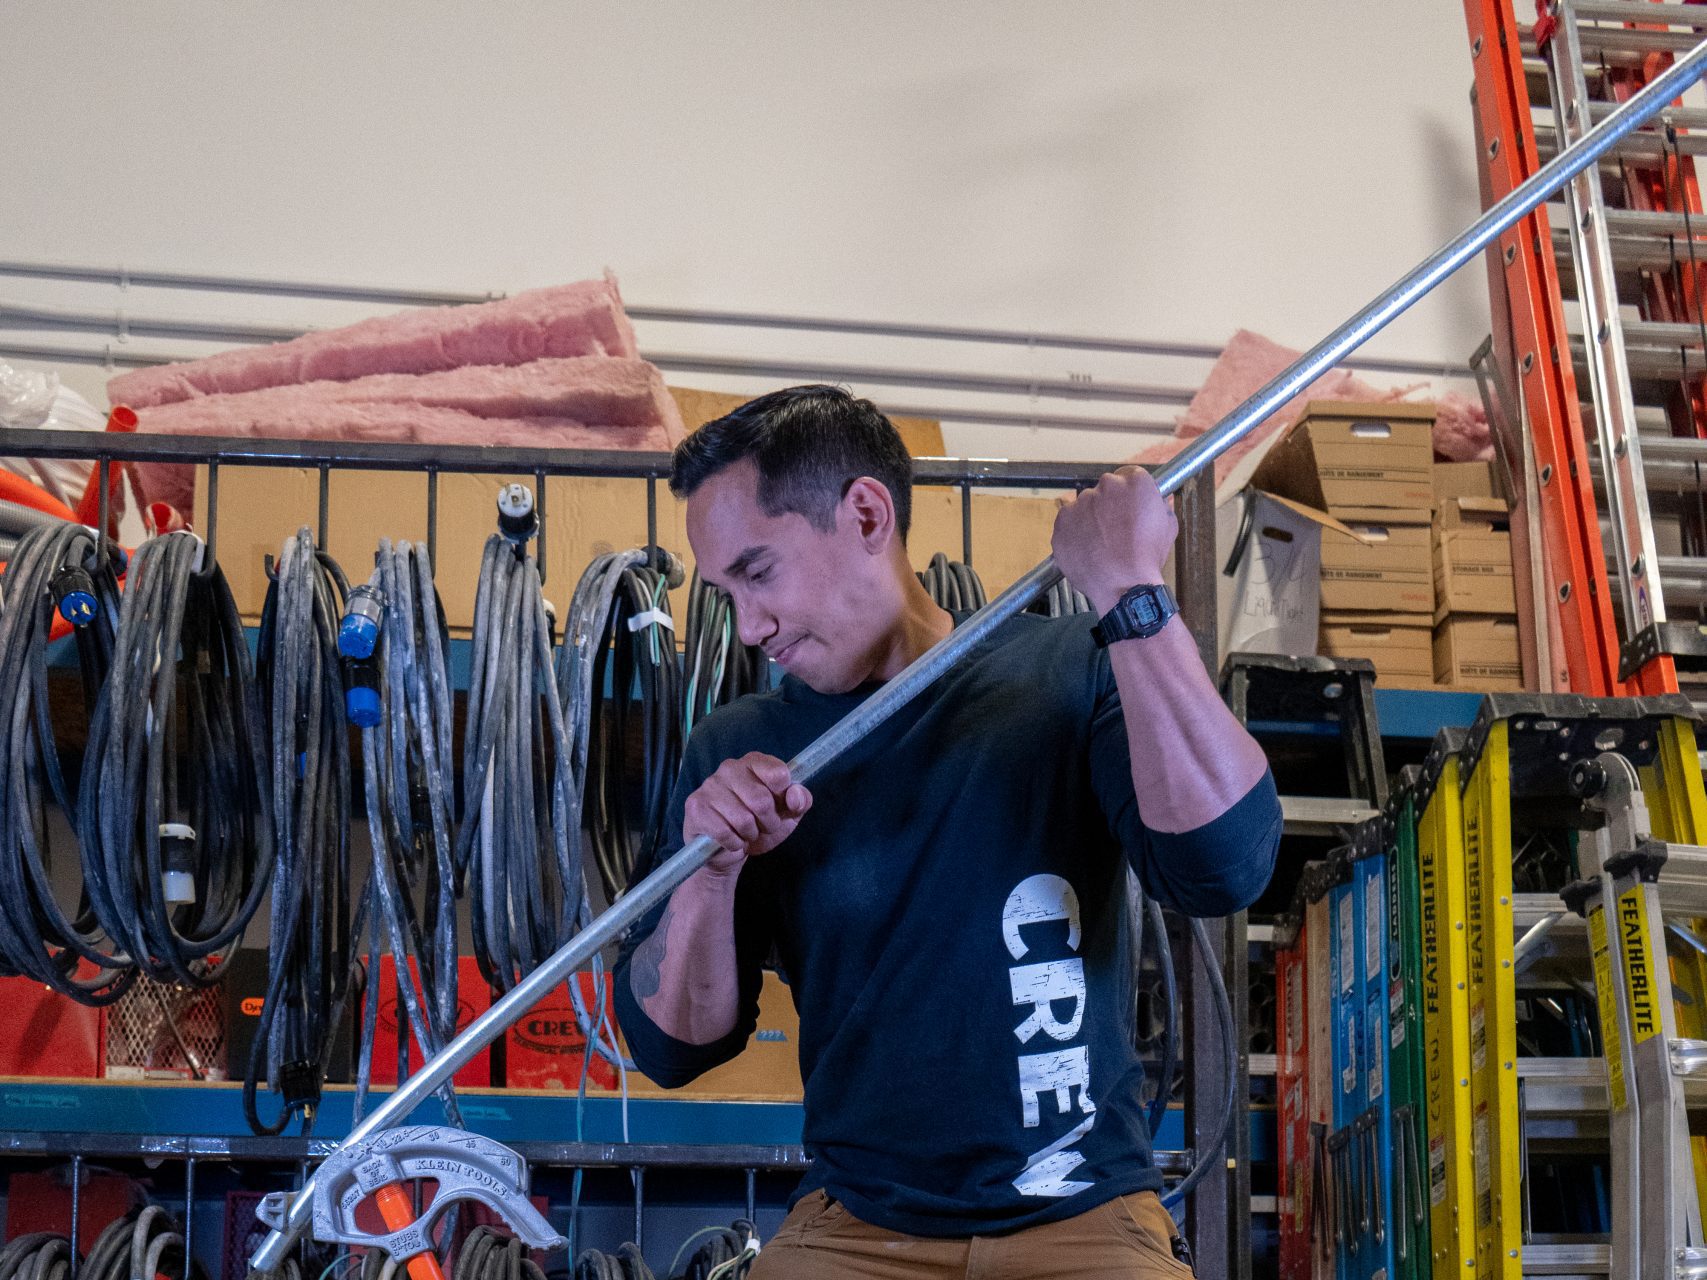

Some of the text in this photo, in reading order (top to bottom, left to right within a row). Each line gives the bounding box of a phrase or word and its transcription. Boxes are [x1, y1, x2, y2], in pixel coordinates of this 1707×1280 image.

[1466, 815, 1484, 984] FEATHERLITE
[1422, 852, 1439, 1014] FEATHERLITE
[1621, 897, 1654, 1034] FEATHERLITE
[1002, 873, 1097, 1197] CREW
[361, 1159, 384, 1174] BACK
[428, 1130, 440, 1142] 30
[465, 1139, 477, 1149] 45
[500, 1157, 512, 1167] 60
[368, 1174, 389, 1188] BEND
[370, 1169, 380, 1178] OF
[416, 1159, 508, 1196] KLEIN TOOLS
[390, 1229, 419, 1249] STUBS
